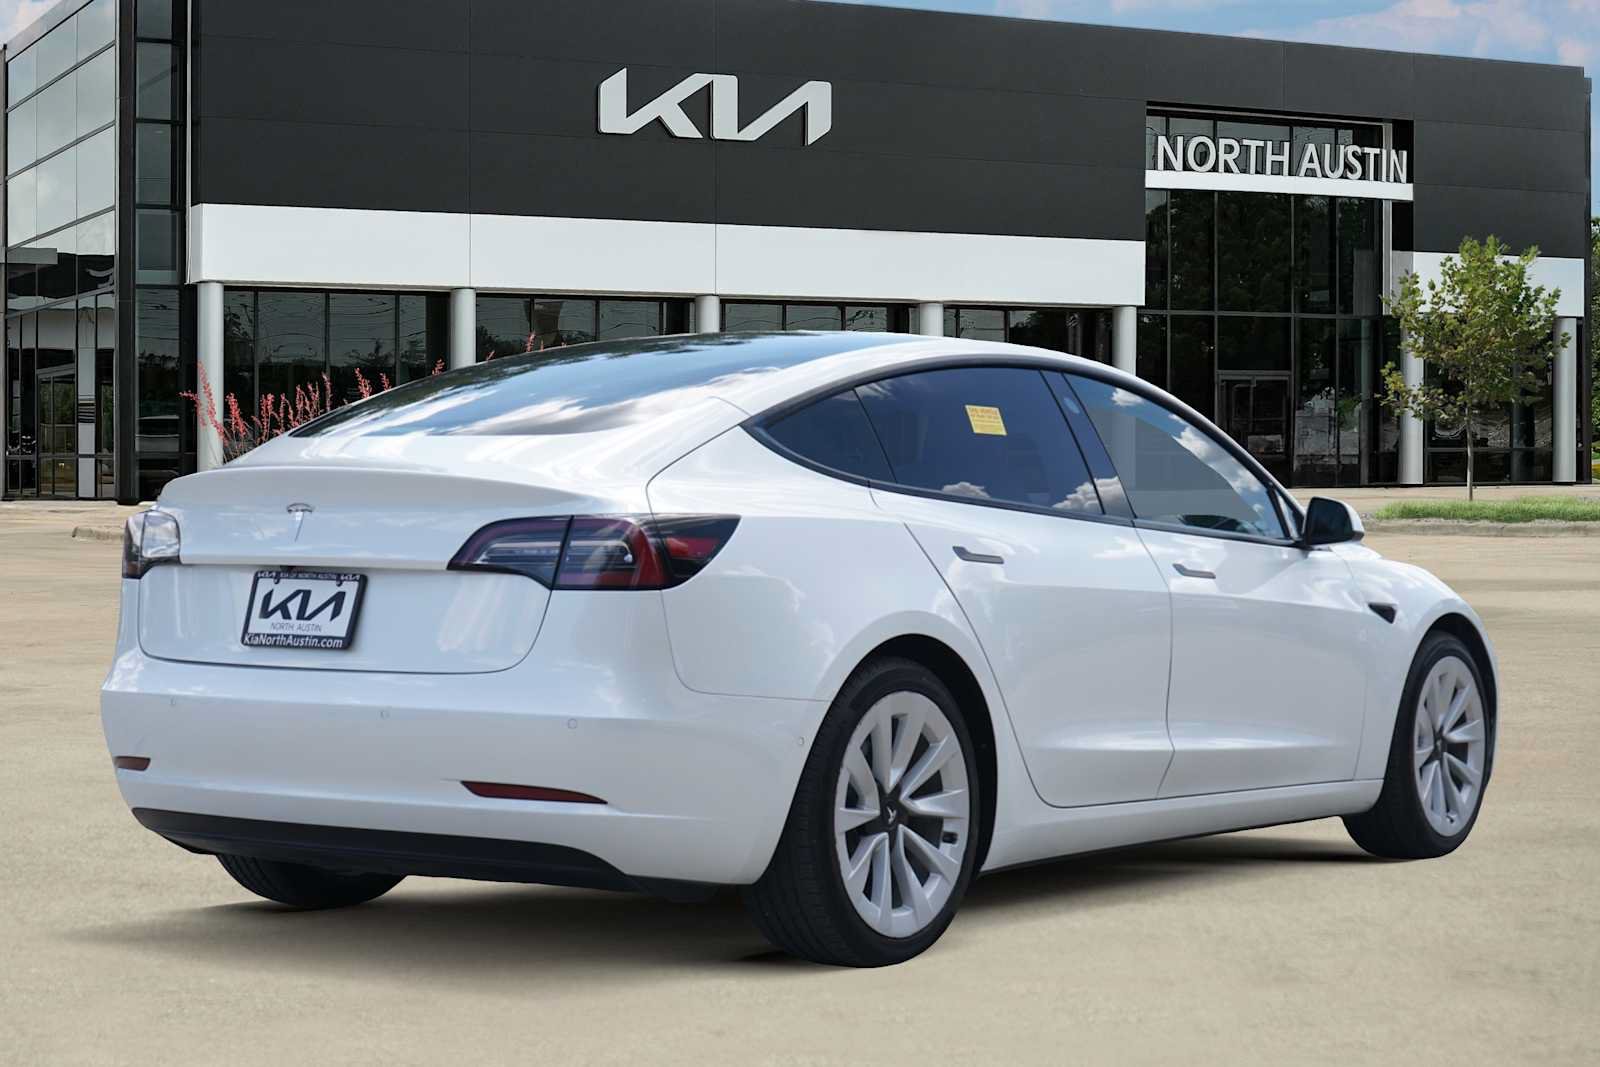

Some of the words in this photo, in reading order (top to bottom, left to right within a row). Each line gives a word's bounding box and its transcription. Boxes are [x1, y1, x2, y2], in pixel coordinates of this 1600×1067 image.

[598, 67, 832, 146] KIA
[1157, 135, 1290, 176] NORTH
[1298, 143, 1408, 185] AUSTIN
[259, 588, 346, 622] KIA
[243, 633, 343, 648] KiaNorthAustin.com
[271, 622, 295, 632] NORTH
[297, 623, 322, 632] AUSTIN
